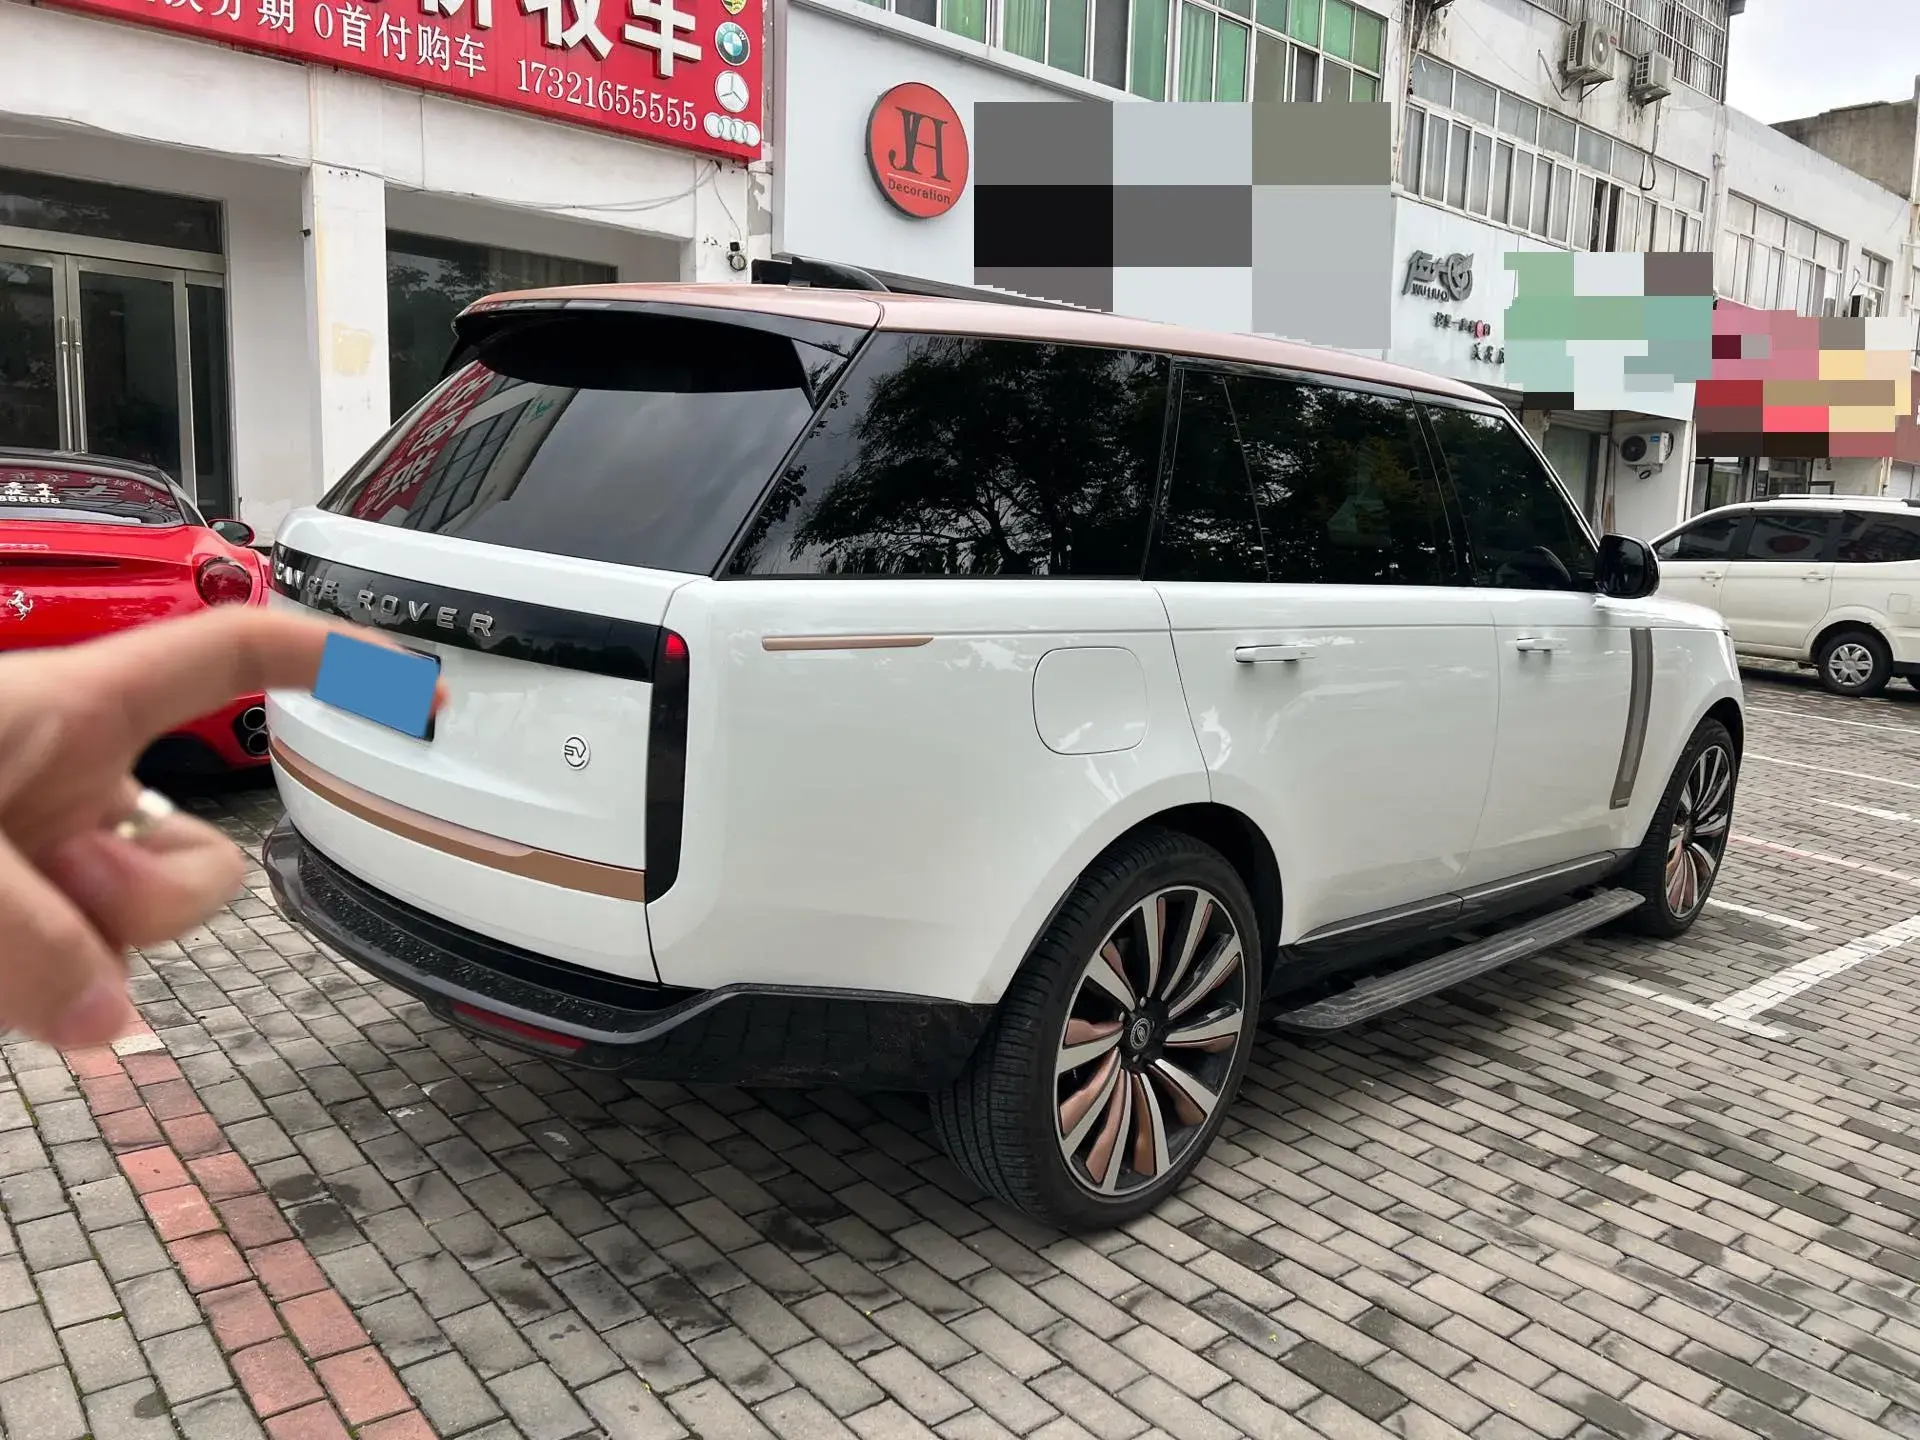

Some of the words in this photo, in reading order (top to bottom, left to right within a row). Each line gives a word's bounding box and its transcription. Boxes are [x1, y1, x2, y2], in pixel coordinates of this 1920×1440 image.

[313, 5, 486, 78] 0首付购车
[517, 59, 697, 132] 17321655555
[887, 177, 950, 205] Decoration
[357, 588, 496, 637] ROVER
